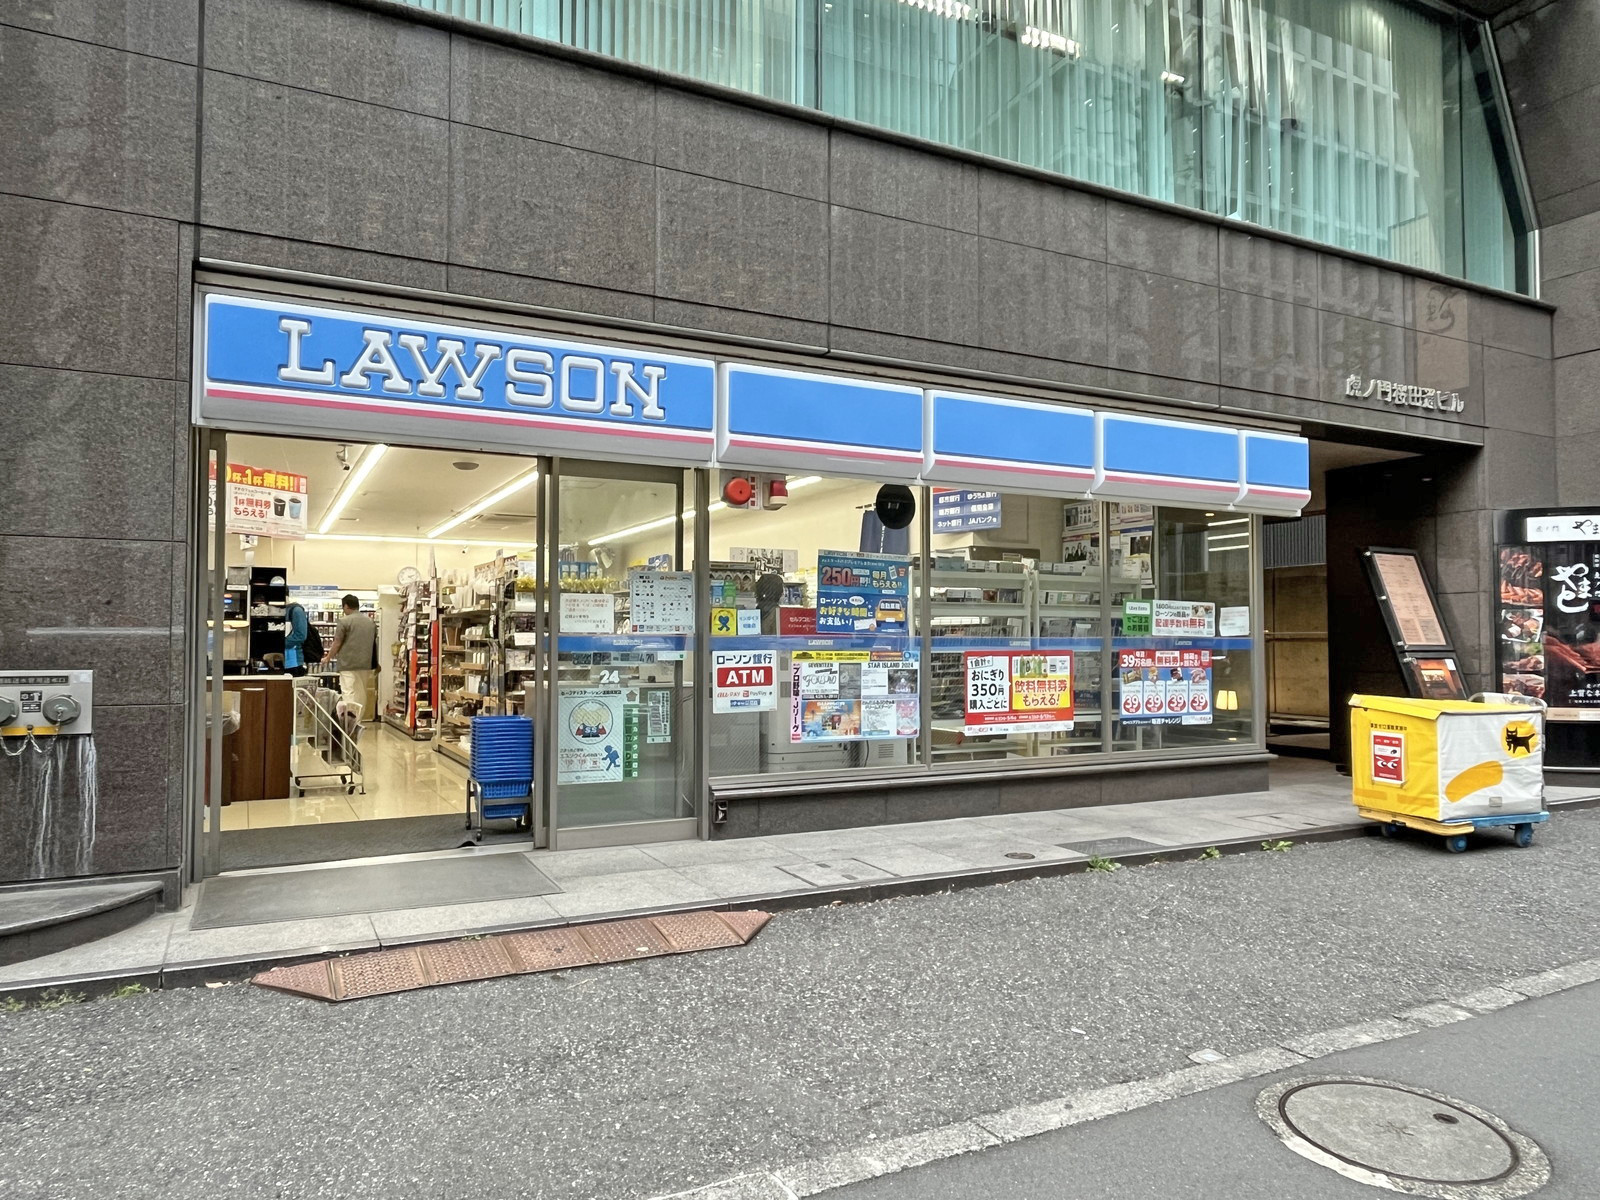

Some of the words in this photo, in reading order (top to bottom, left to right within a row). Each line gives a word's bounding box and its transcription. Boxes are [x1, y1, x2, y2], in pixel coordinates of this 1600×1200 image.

[278, 318, 666, 421] LAWSON
[820, 597, 848, 605] ローソンで
[716, 653, 773, 665] ローソン銀行
[600, 670, 620, 684] 24
[726, 669, 765, 685] ATM
[971, 669, 1004, 681] おにぎり
[971, 683, 1004, 696] 350円
[1015, 680, 1067, 693] 飲料無料券
[969, 699, 1008, 710] 購入ごとに
[1023, 693, 1060, 706] もらえる!
[1125, 695, 1139, 709] 39
[1147, 694, 1161, 708] 39
[1170, 694, 1184, 707] 39
[1192, 694, 1206, 707] 39
